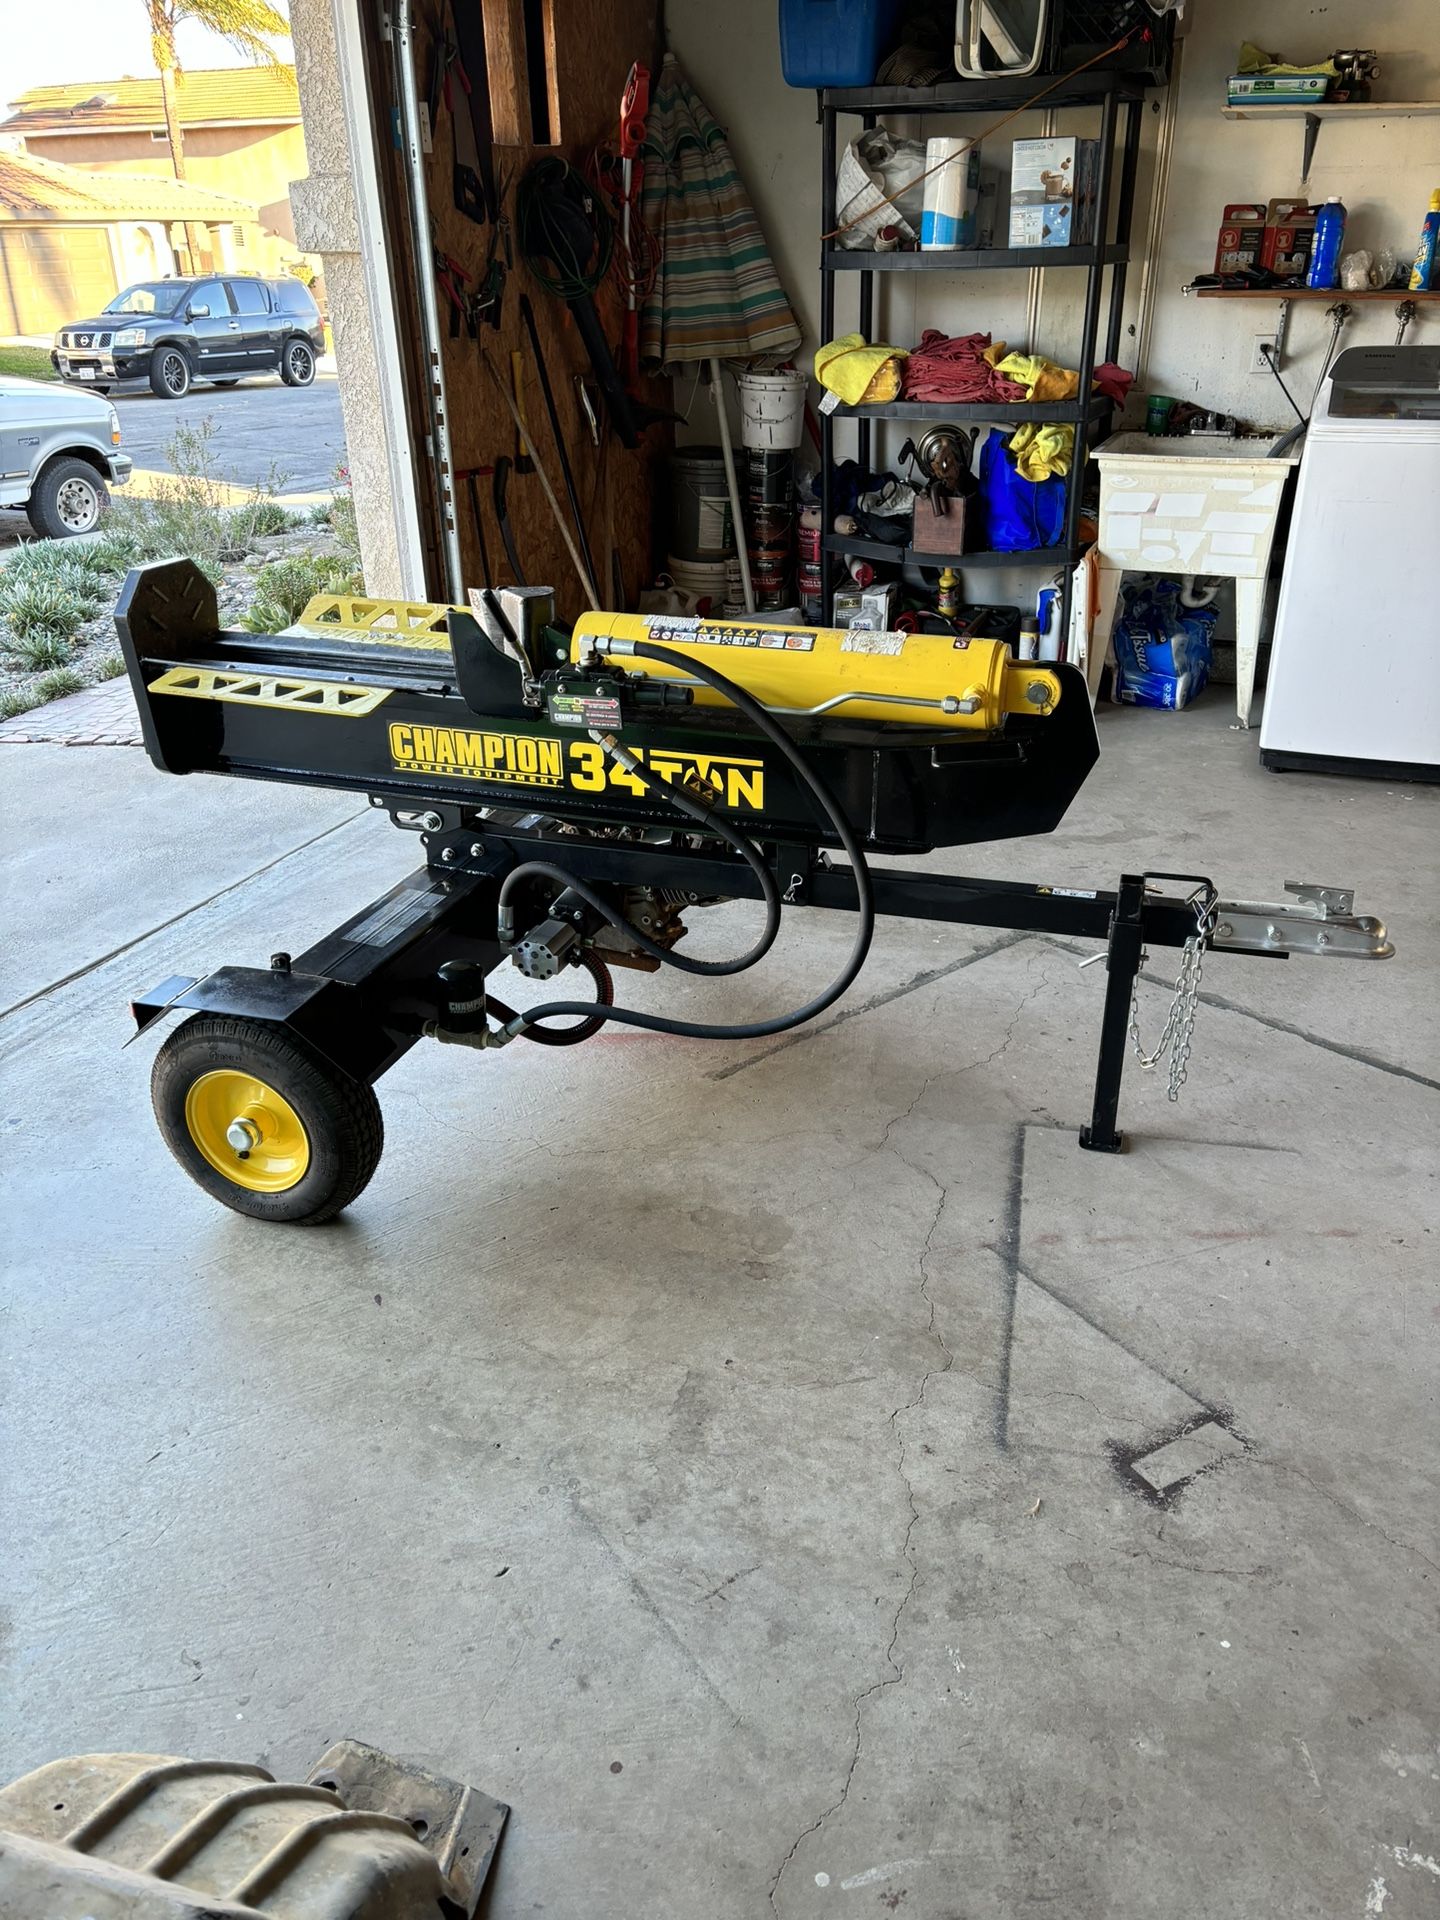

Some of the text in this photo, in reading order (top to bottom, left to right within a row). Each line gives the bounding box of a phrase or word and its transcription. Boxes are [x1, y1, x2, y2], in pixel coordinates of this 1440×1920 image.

[1129, 631, 1152, 673] Tissue
[391, 725, 561, 777] CHAMPION
[399, 761, 560, 786] POWER EQUIPMENT
[569, 741, 650, 797] 34
